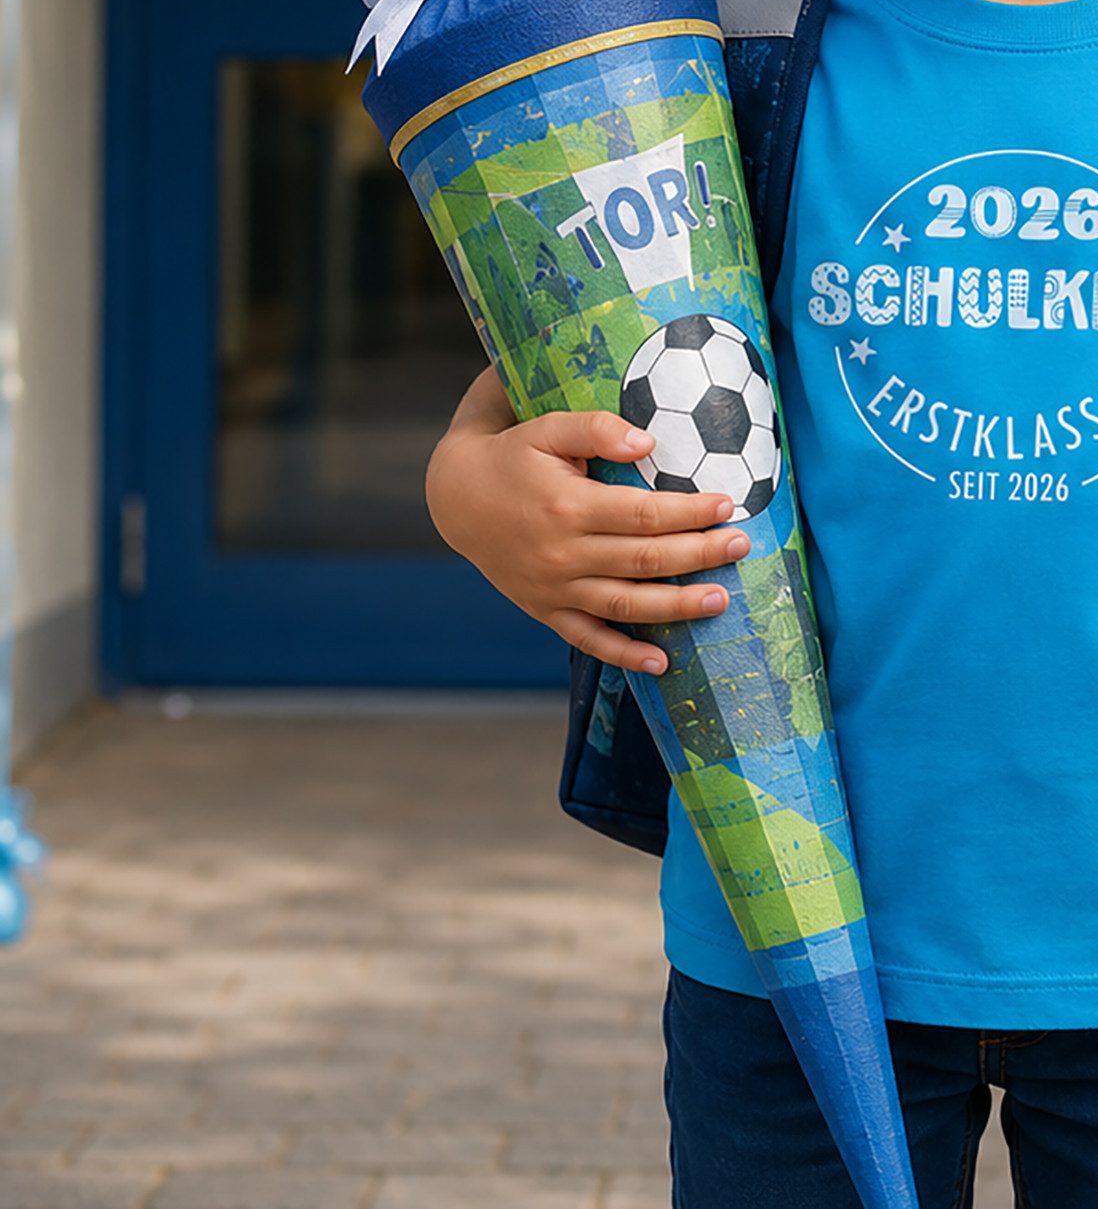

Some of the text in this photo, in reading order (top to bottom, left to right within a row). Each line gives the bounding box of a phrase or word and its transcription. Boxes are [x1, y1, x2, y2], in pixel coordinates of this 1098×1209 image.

[555, 160, 717, 271] TOR!
[949, 471, 1069, 501] SEIT 2026
